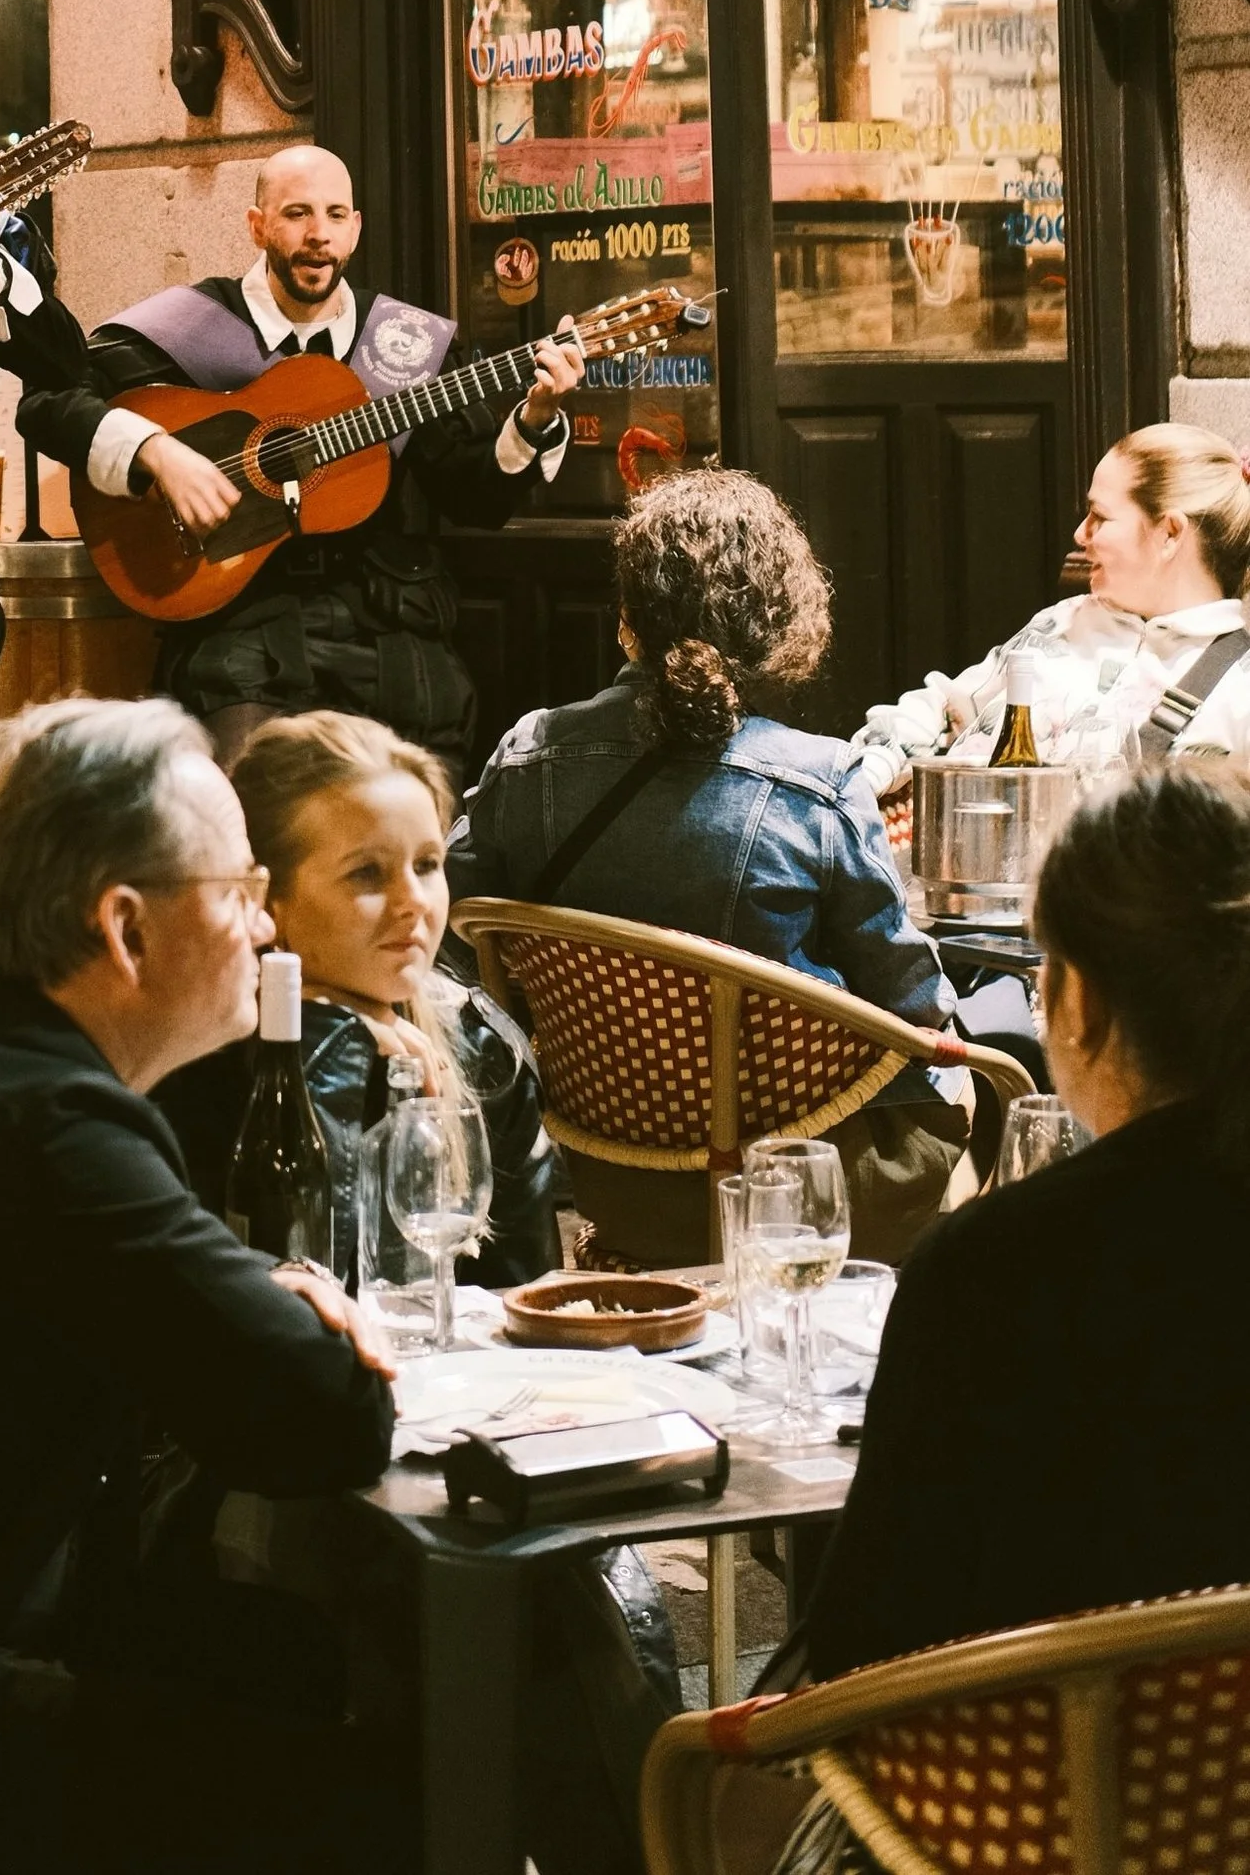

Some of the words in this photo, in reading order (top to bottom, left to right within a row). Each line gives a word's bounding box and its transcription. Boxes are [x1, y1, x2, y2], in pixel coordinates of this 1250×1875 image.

[466, 0, 605, 84] GAMBAS
[478, 164, 558, 217] GAMBAS
[562, 163, 585, 211] al
[586, 157, 664, 213] AJILLO
[552, 228, 601, 261] ración
[605, 221, 658, 260] 1000
[661, 221, 692, 255] PTS
[627, 352, 712, 390] PLANCHA
